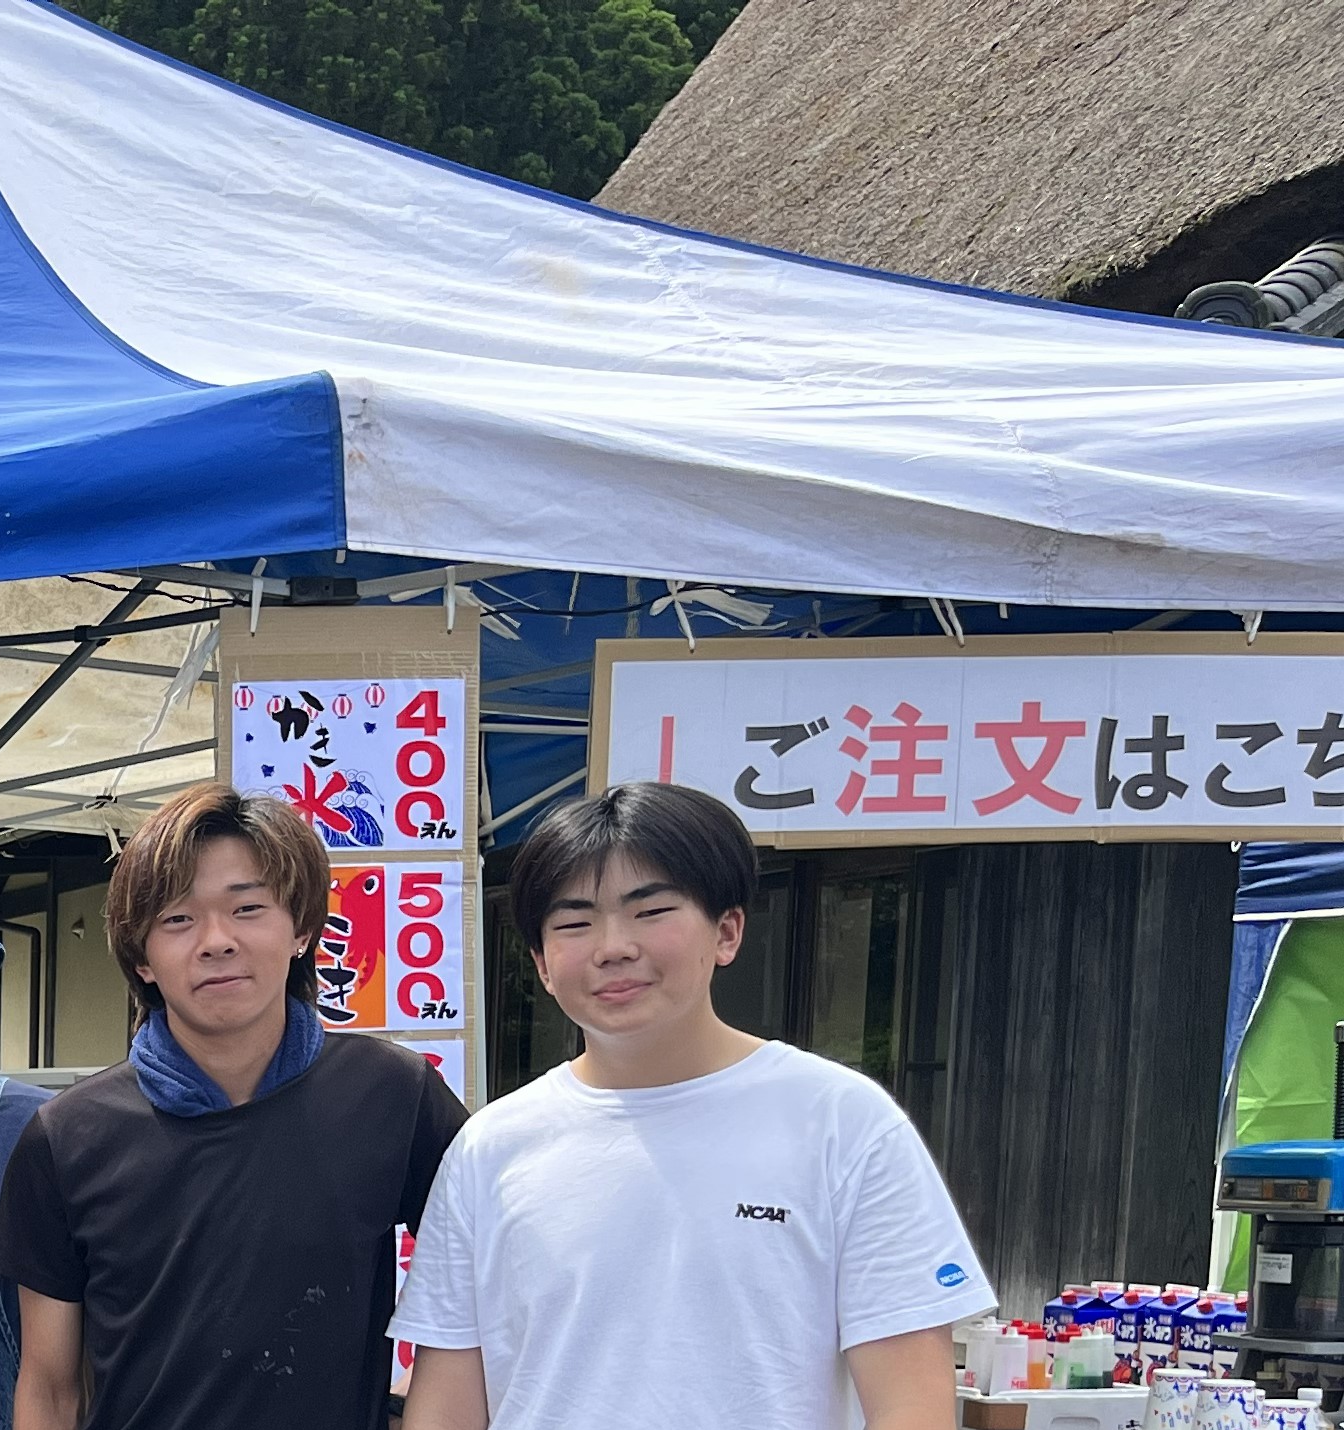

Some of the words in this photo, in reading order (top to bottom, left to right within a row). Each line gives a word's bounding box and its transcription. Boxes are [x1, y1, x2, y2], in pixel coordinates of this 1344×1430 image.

[419, 821, 458, 840] えん
[420, 1001, 459, 1021] えん
[735, 1203, 786, 1224] NCAA
